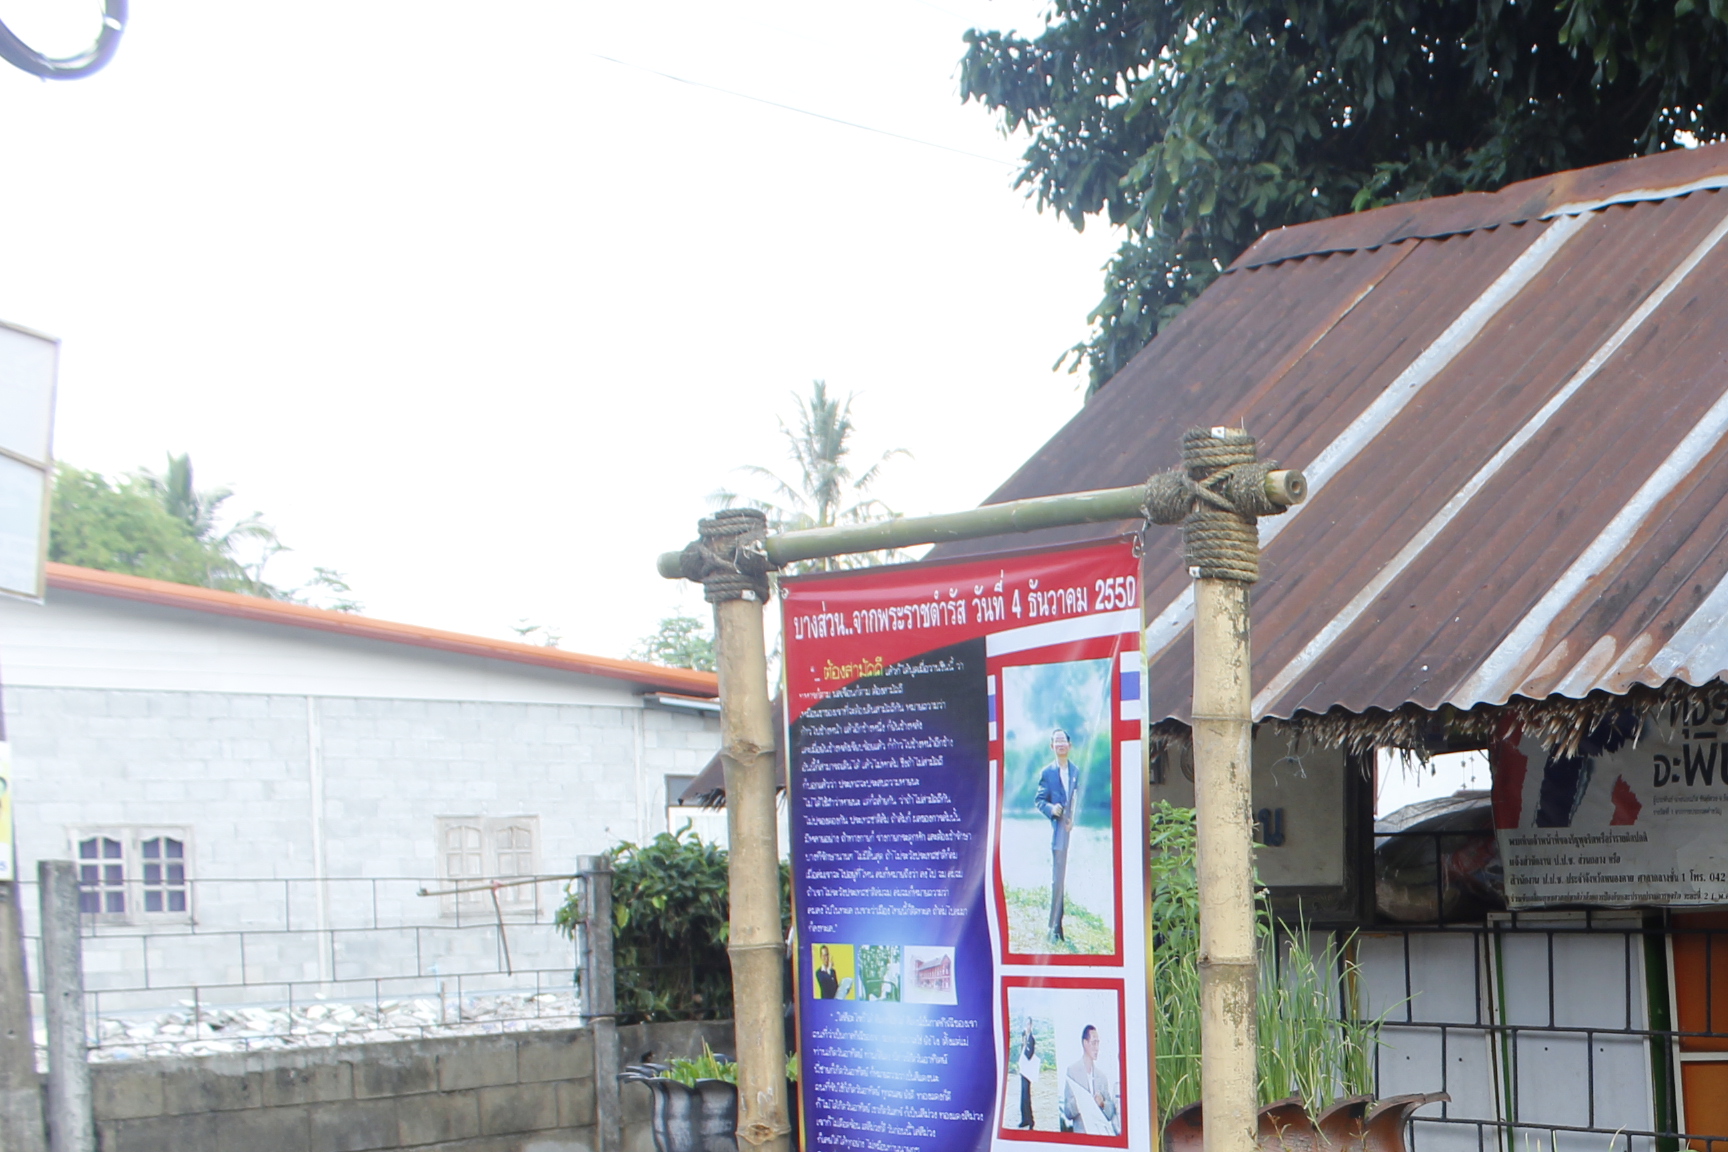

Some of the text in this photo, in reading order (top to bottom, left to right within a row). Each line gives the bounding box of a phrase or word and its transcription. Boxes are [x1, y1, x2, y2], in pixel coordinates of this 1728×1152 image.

[972, 570, 1005, 622] วันที่
[1011, 589, 1022, 619] 4
[1028, 580, 1088, 616] ธันวาคม
[1095, 575, 1136, 611] 2550
[1709, 872, 1726, 882] 042
